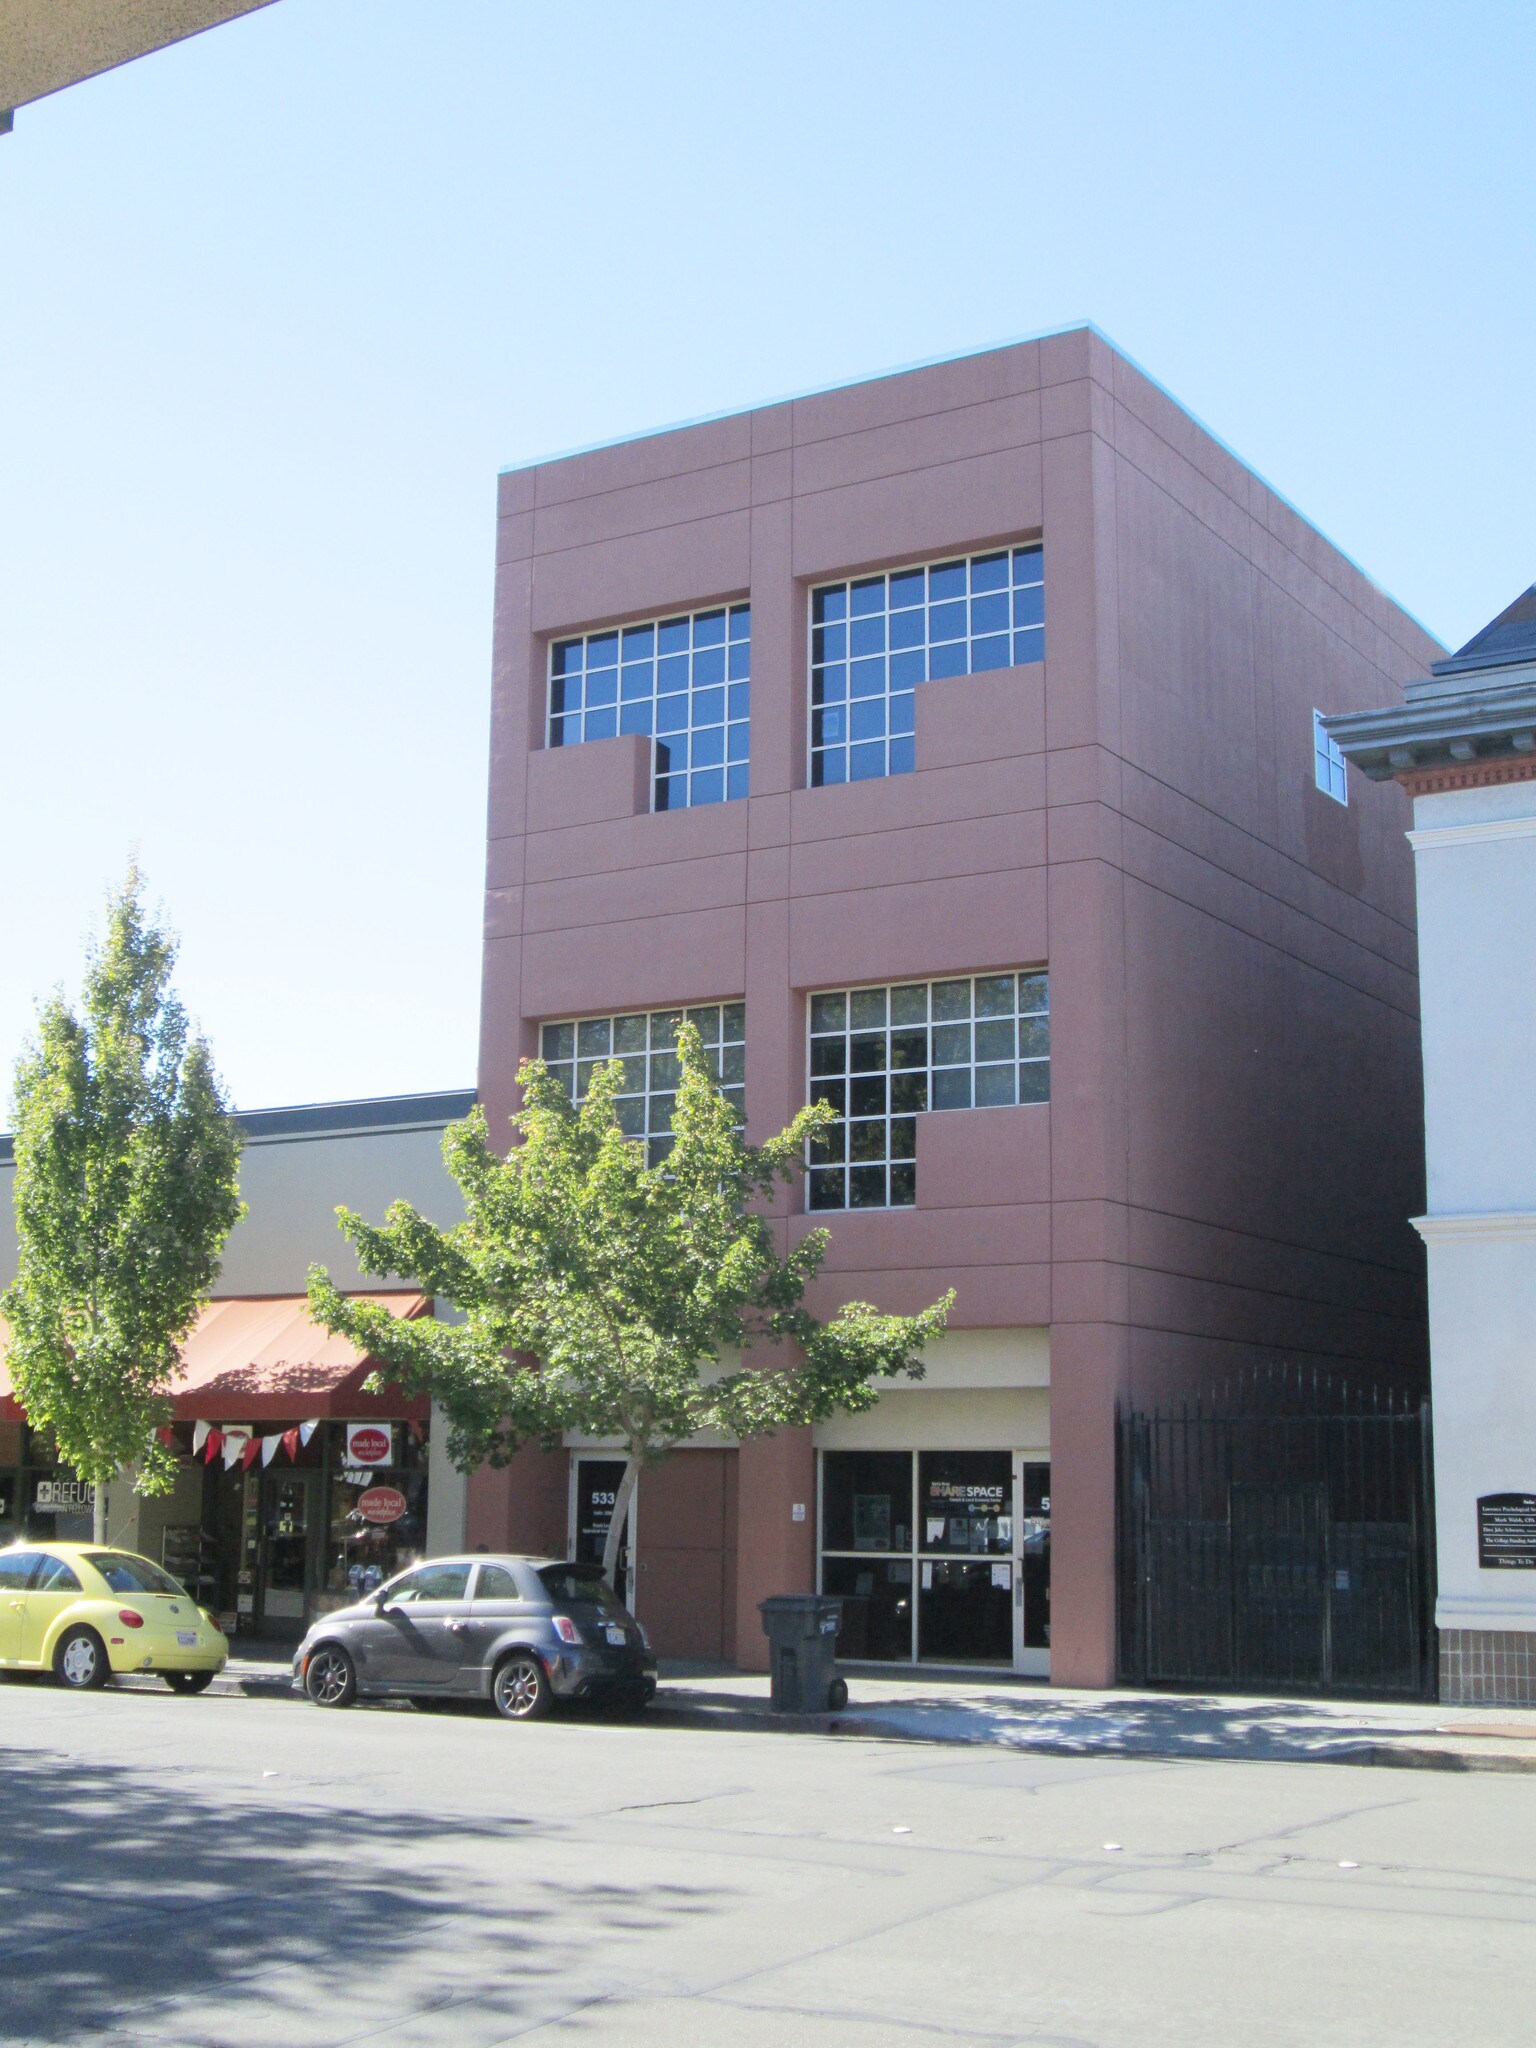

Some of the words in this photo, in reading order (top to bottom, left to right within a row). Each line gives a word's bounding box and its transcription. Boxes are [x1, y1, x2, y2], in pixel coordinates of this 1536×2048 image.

[352, 1439, 369, 1448] made
[371, 1438, 386, 1447] local
[52, 1482, 96, 1504] REFUG
[592, 1492, 615, 1504] 533
[361, 1497, 382, 1507] made
[384, 1497, 401, 1507] local
